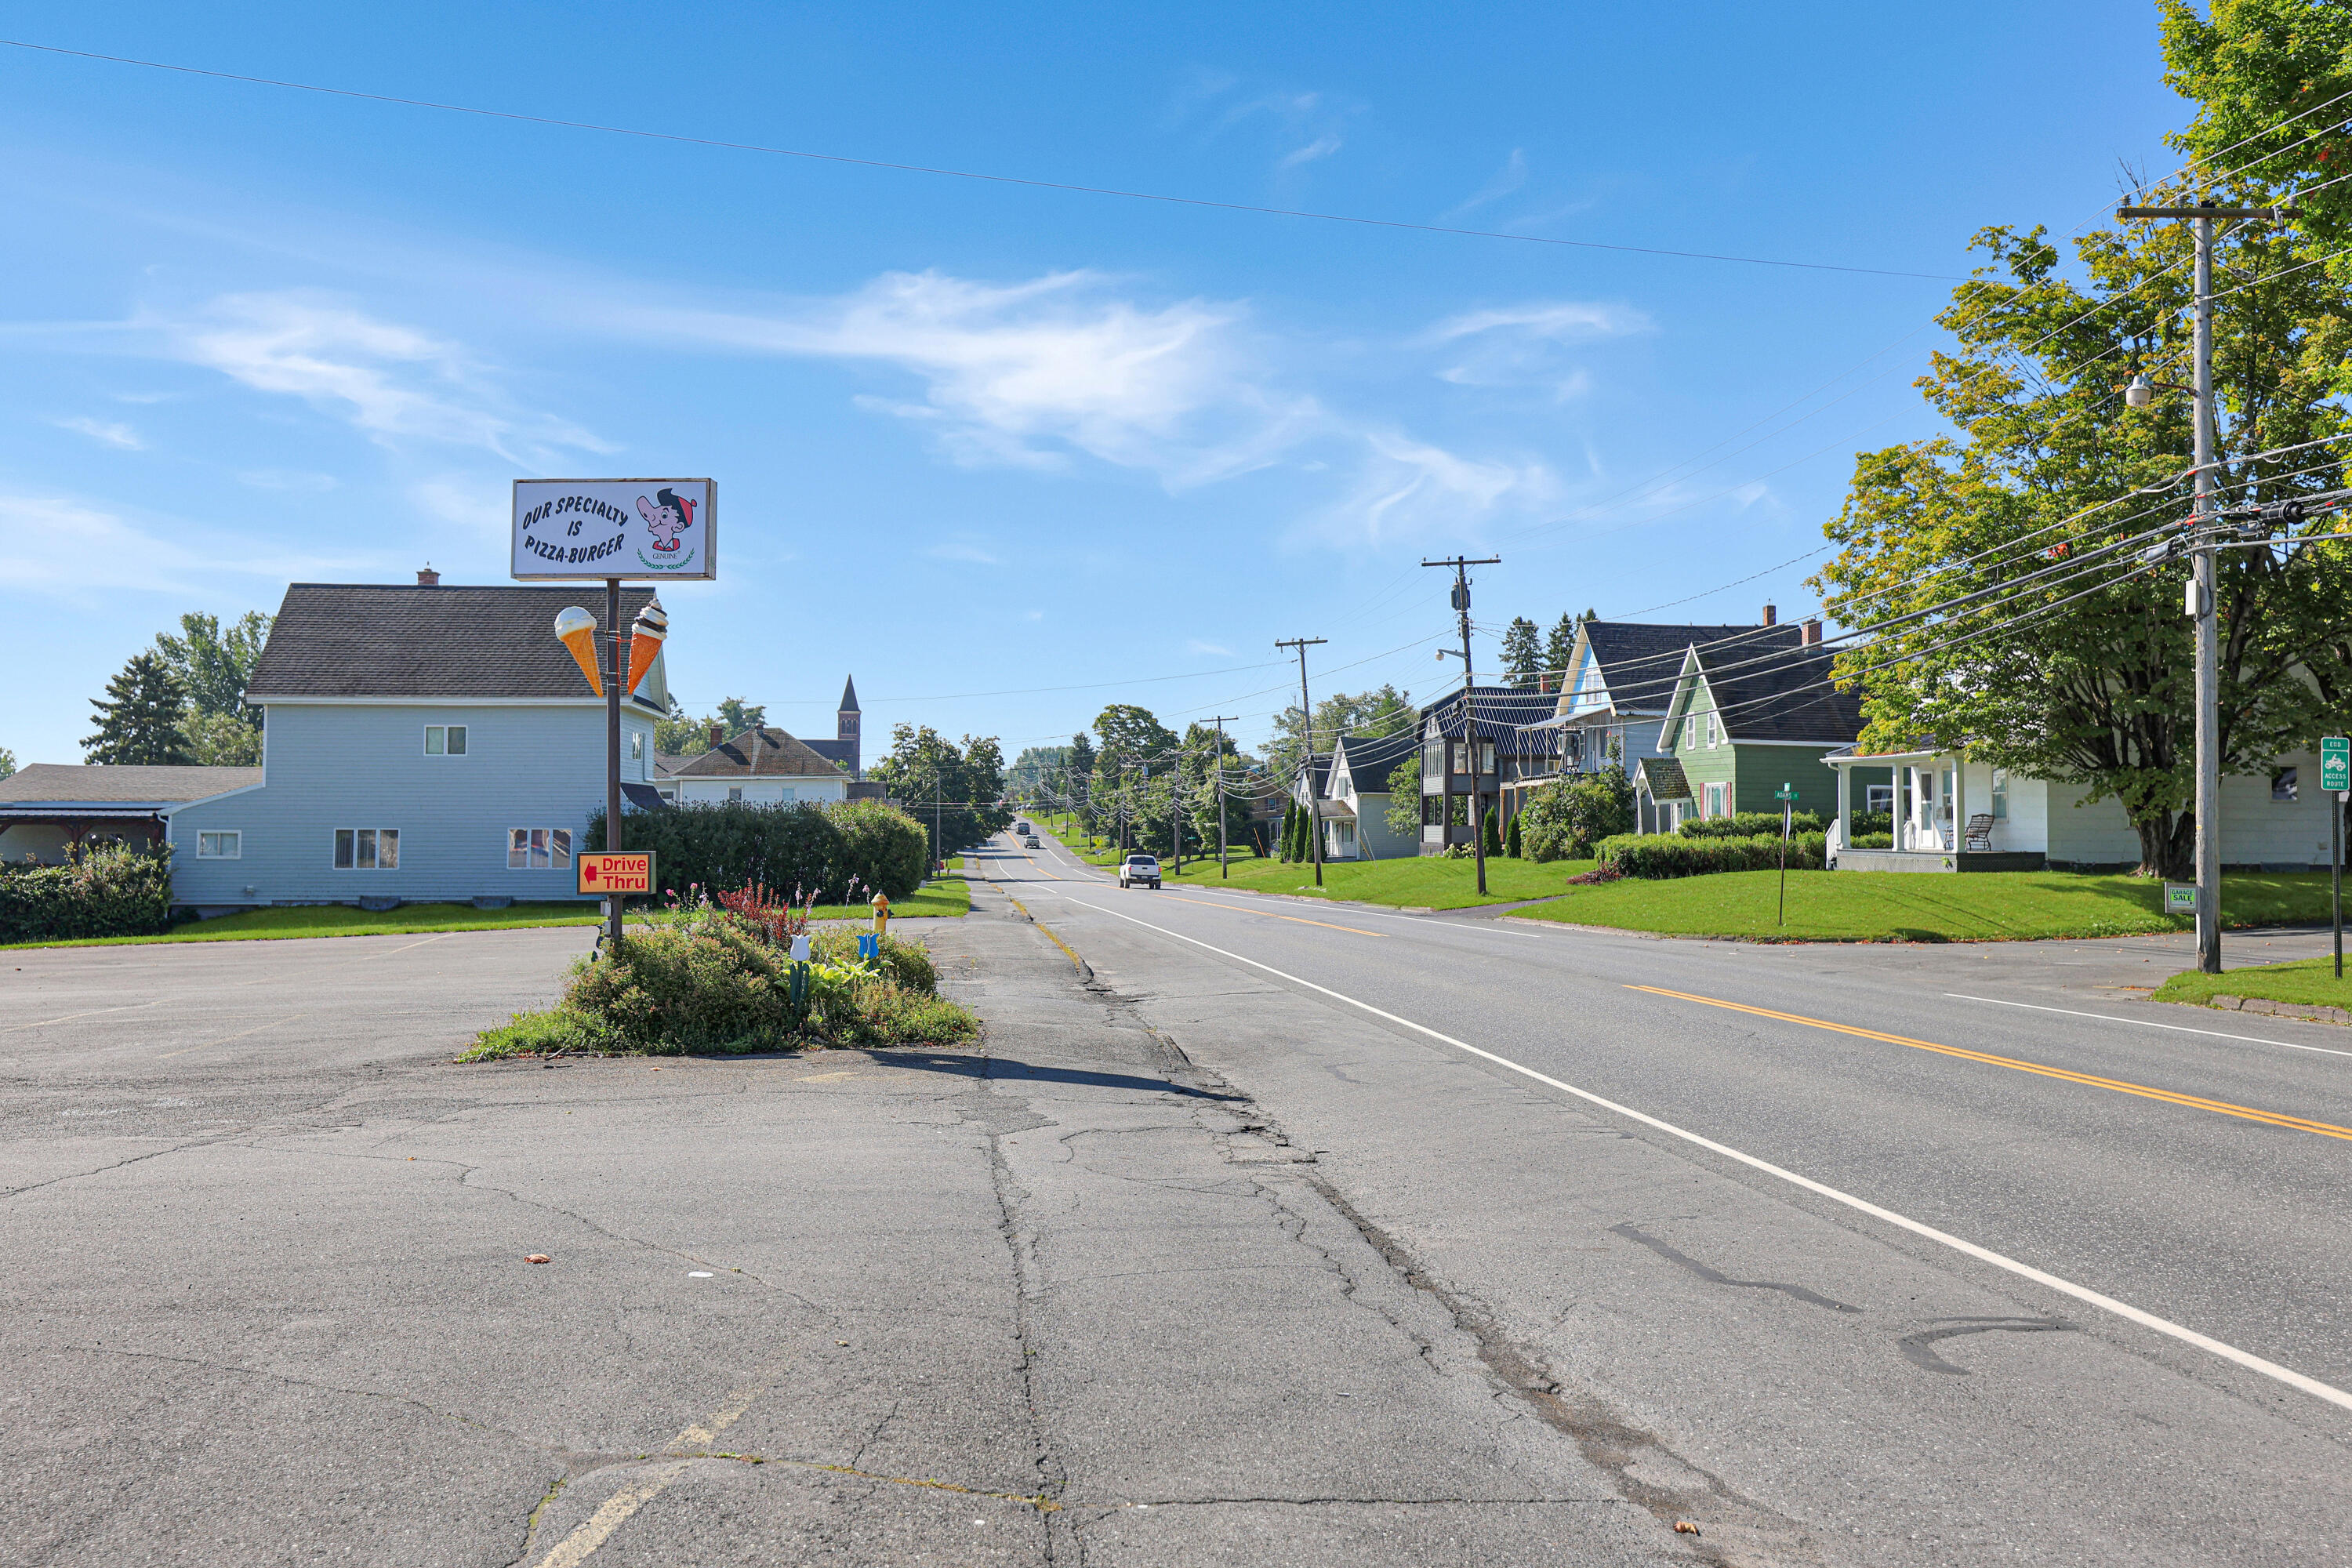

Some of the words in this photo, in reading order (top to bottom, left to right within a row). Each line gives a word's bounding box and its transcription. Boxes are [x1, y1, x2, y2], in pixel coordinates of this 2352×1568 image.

[523, 501, 552, 530] OUR
[555, 495, 628, 527] SPECIALTY
[567, 520, 583, 536] IS
[524, 533, 625, 564] PIZZA-BURGER
[602, 857, 647, 871] Drive
[602, 875, 645, 889] Thru
